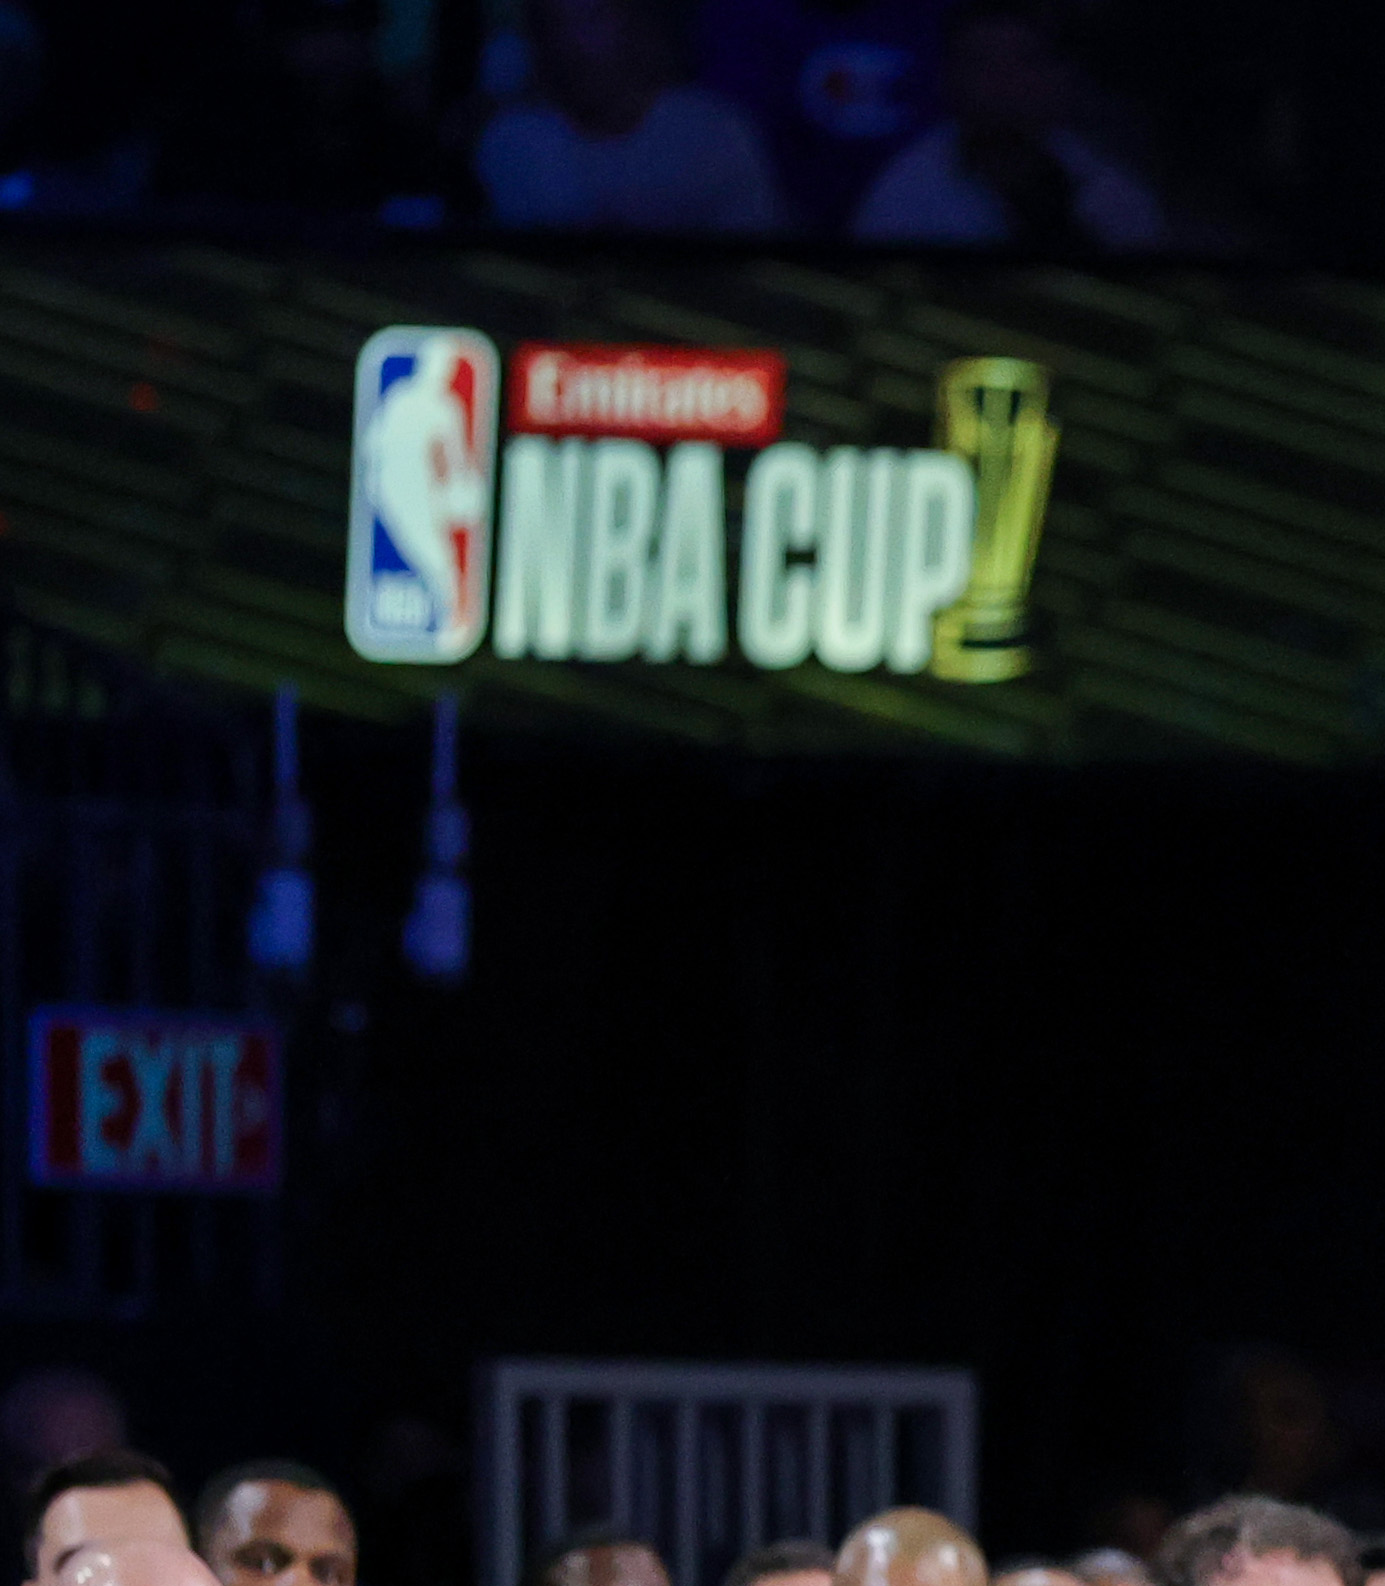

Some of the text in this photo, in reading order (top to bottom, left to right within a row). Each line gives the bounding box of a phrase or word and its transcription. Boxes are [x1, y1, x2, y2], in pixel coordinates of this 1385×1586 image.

[493, 434, 977, 674] NBA CUP
[80, 1032, 240, 1175] EXIT
